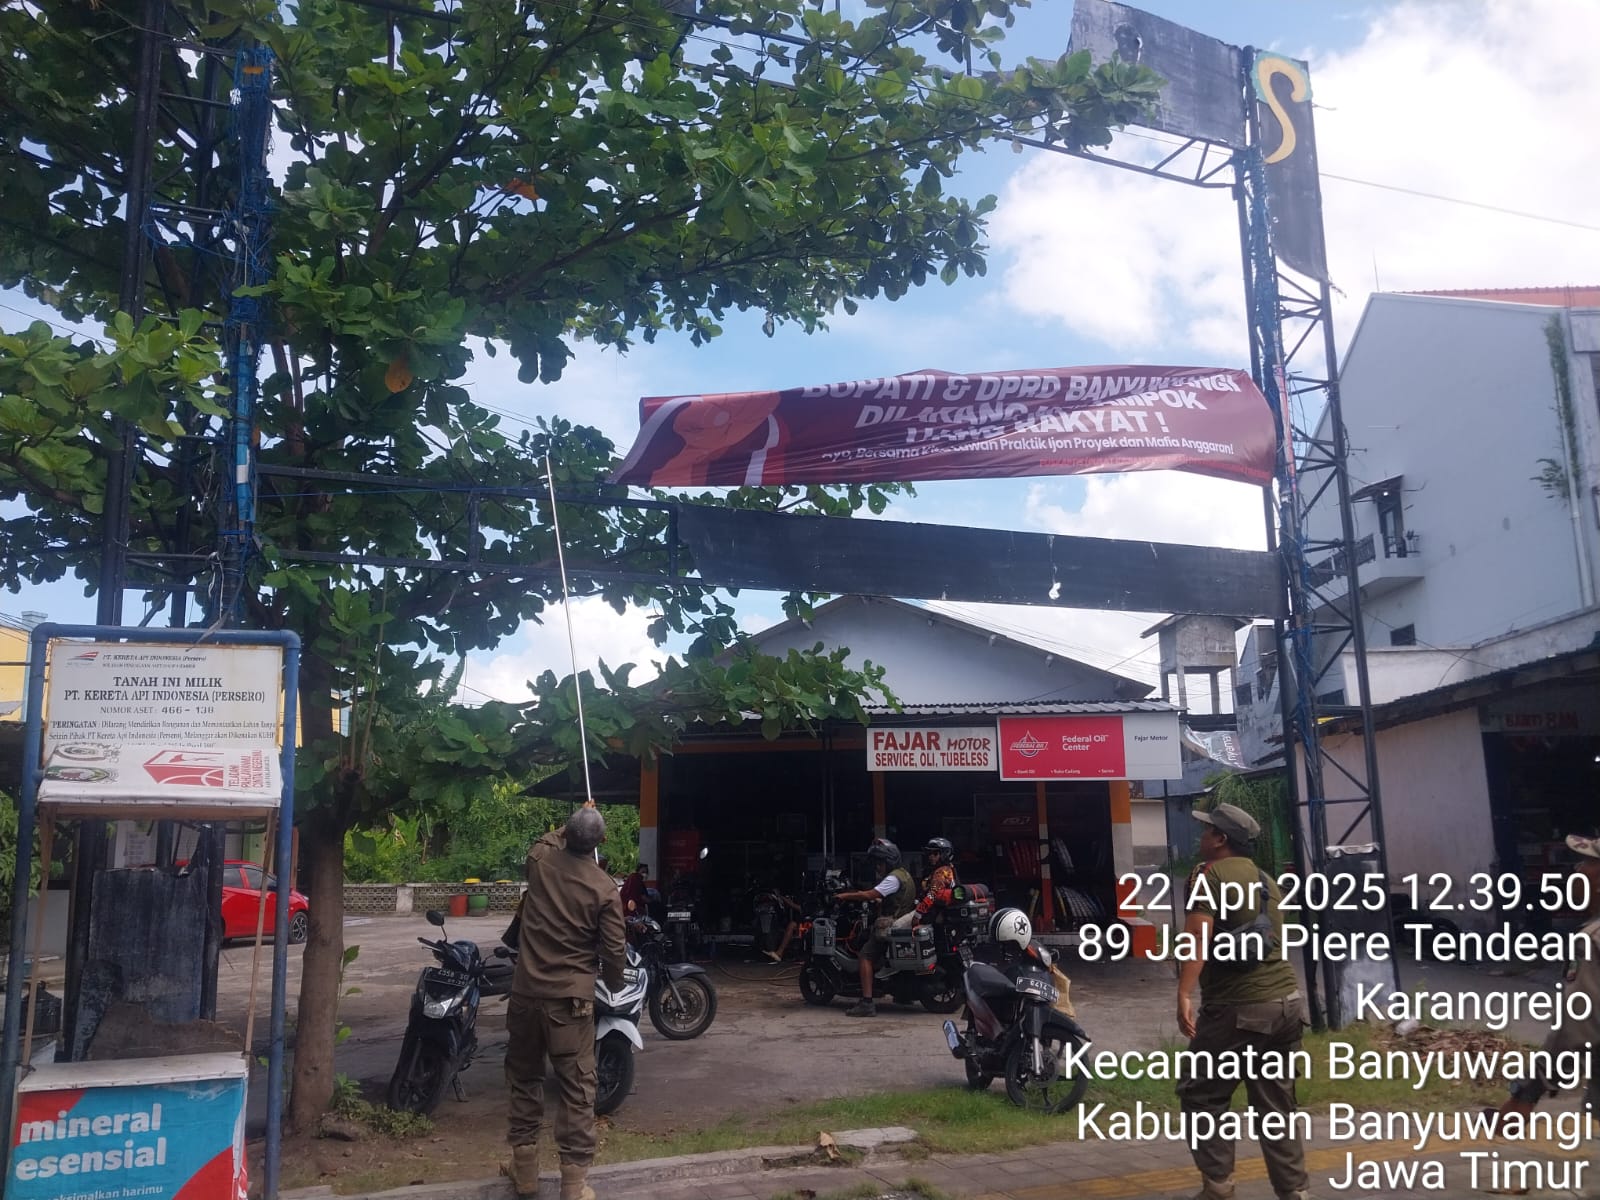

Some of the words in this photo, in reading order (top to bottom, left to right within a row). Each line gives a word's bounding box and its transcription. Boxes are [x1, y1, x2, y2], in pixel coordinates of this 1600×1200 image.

[942, 375, 971, 401] &
[975, 375, 1061, 402] DPRD
[1154, 411, 1170, 433] !
[1000, 437, 1047, 451] Praktik
[1048, 437, 1073, 453] Ijon
[1074, 438, 1117, 452] Proyek
[1119, 437, 1143, 448] dan
[1147, 437, 1181, 449] Mafia
[1181, 438, 1235, 456] Anggaran!
[113, 676, 158, 688] TANAH
[162, 677, 181, 688] INI
[185, 677, 223, 688] MILIK
[64, 690, 80, 701] PT.
[84, 690, 128, 701] KERETA
[131, 690, 149, 701] API
[152, 690, 210, 702] INDONESIA
[211, 691, 265, 704] (PERSERO)
[100, 706, 132, 714] NOMOR
[873, 731, 941, 751] FAJAR
[947, 737, 991, 752] MOTOR
[1062, 734, 1092, 743] Federal
[1134, 734, 1149, 743] Fajar
[1150, 734, 1169, 742] Motor
[1062, 743, 1090, 751] Center
[875, 752, 918, 768] SERVICE,
[920, 752, 938, 768] OLI,
[940, 752, 989, 767] TUBELESS
[19, 1103, 162, 1144] mineral
[15, 1137, 167, 1181] esensial
[122, 1184, 164, 1196] harimu
